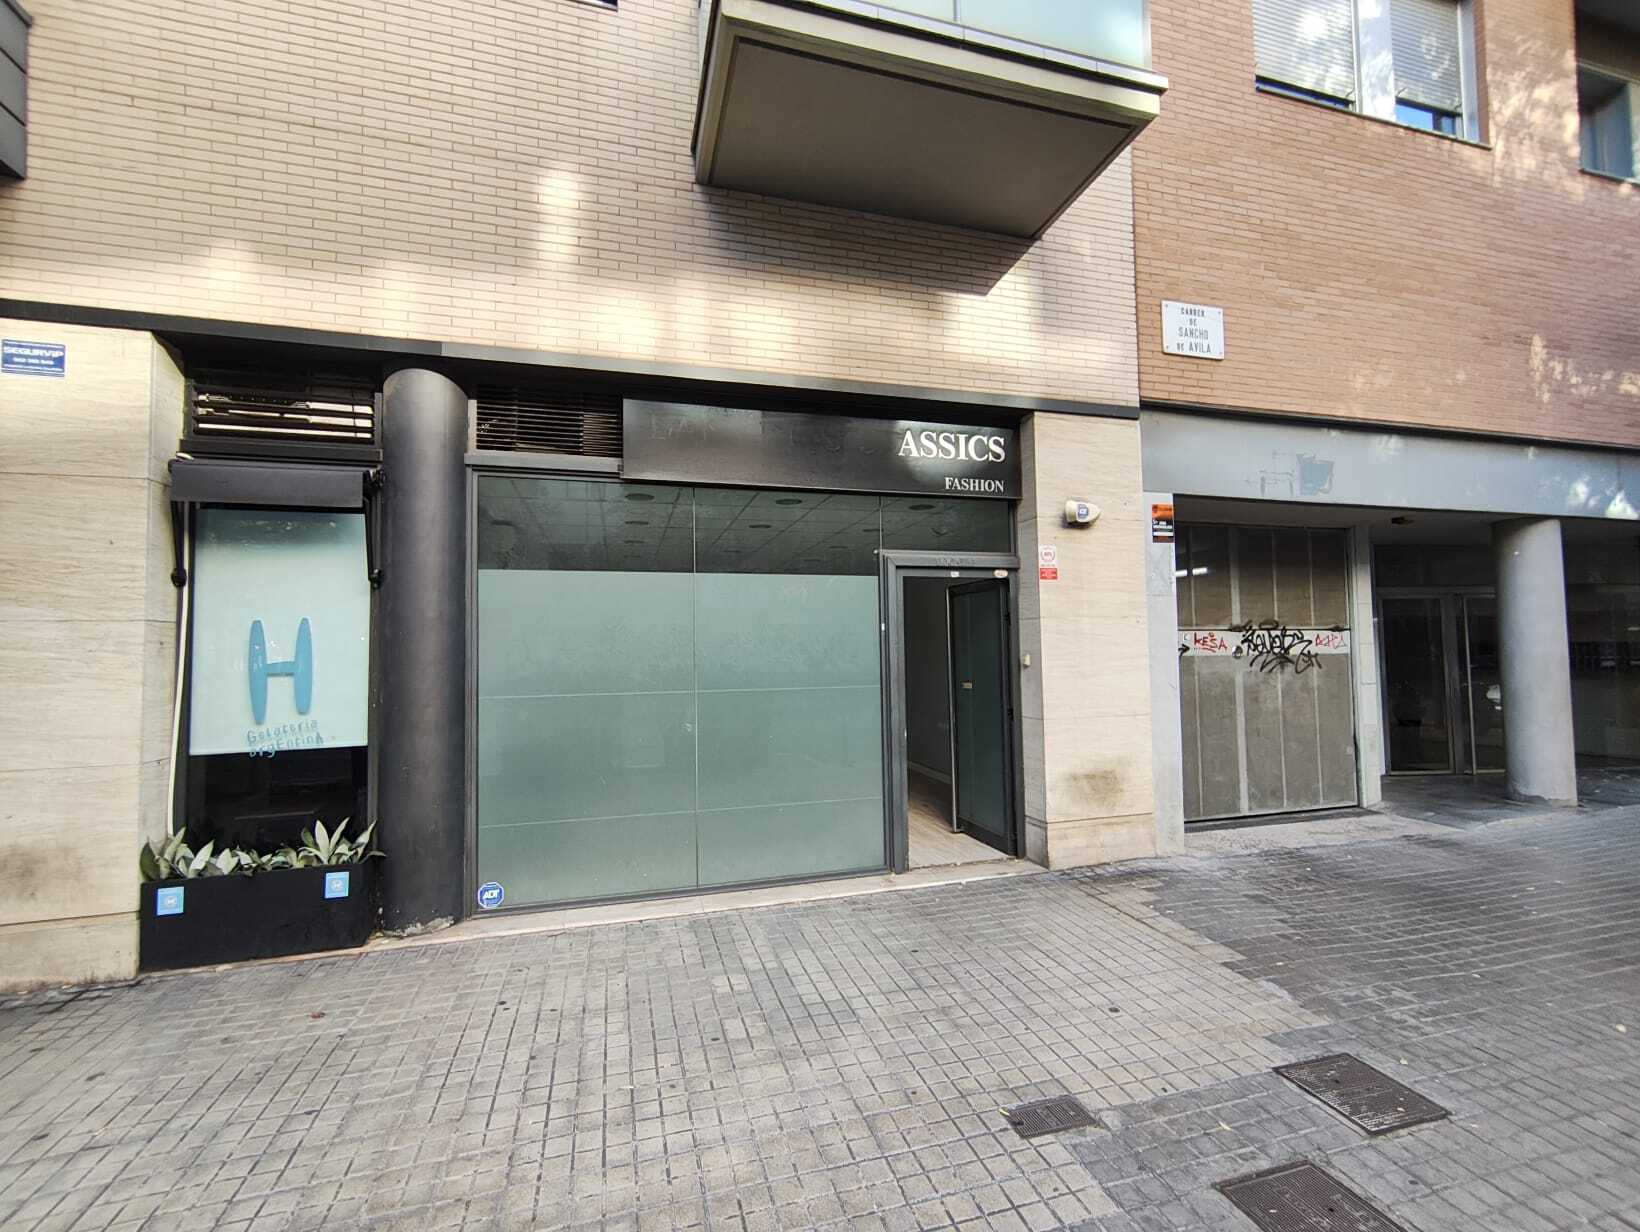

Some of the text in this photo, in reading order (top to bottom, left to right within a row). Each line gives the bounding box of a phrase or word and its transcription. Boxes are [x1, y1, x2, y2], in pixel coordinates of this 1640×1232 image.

[1181, 307, 1205, 317] CARRER
[1189, 319, 1197, 327] DE
[1178, 327, 1209, 340] SANCHO
[1176, 342, 1185, 351] DE
[897, 429, 1006, 463] ASSICS
[944, 477, 1004, 493] FASHION
[248, 617, 313, 725] H
[482, 889, 500, 900] ADT
